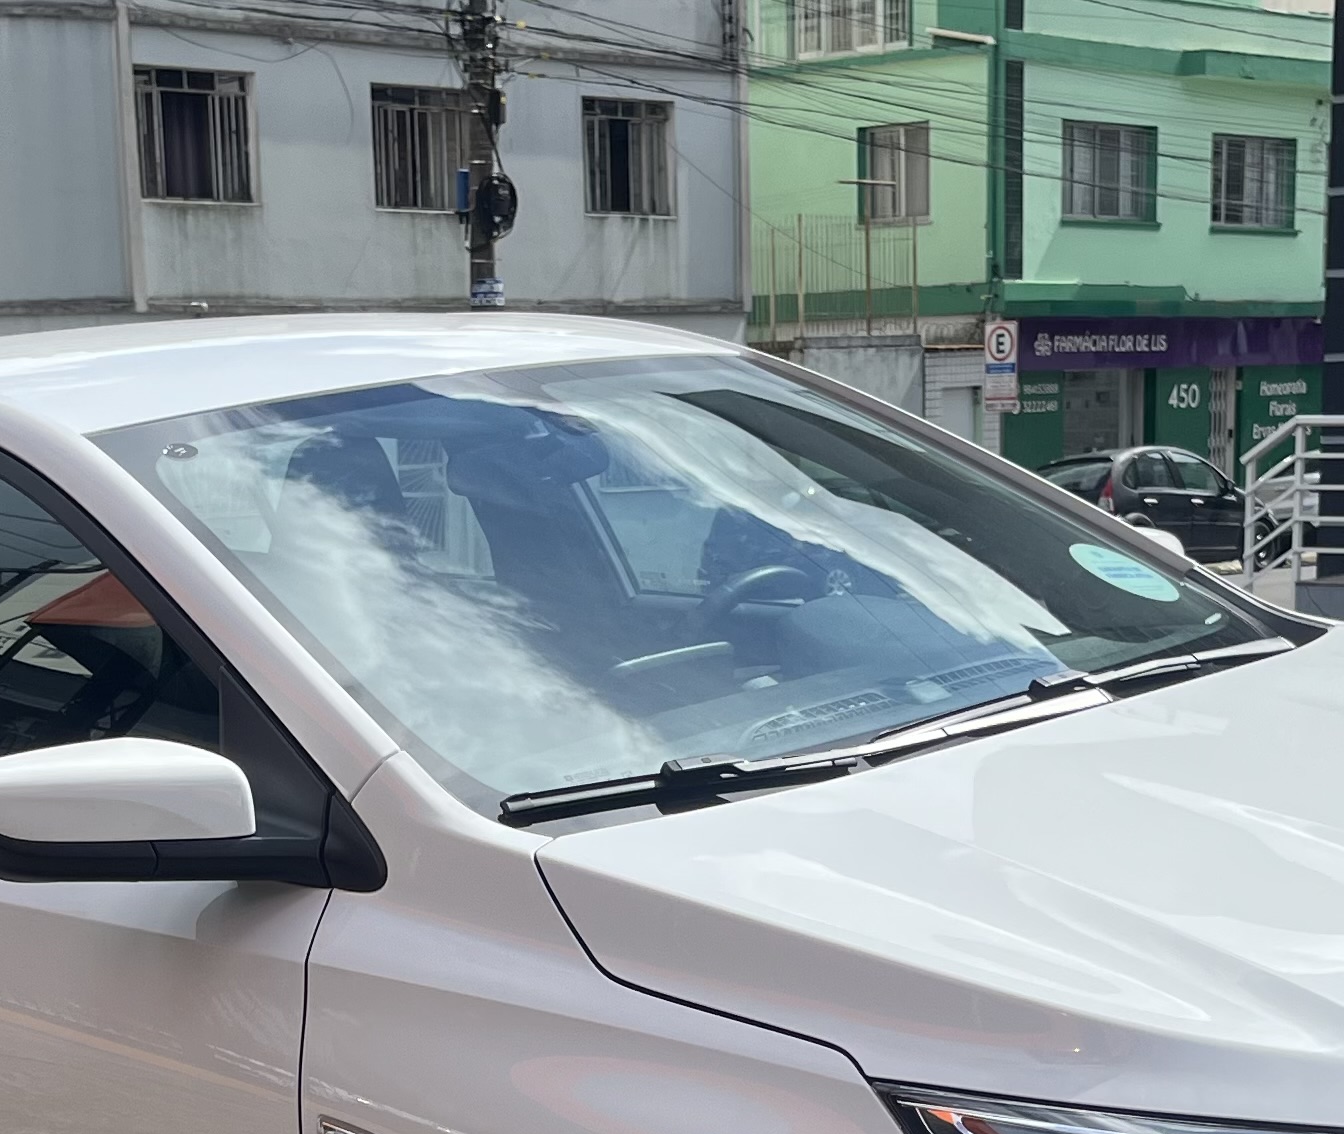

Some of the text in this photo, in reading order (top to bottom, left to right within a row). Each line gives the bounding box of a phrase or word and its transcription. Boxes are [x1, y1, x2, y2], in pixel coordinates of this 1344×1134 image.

[995, 333, 1006, 354] E
[1053, 330, 1168, 352] FARMÁCIA FLOR DE LIS
[1168, 383, 1201, 409] 450
